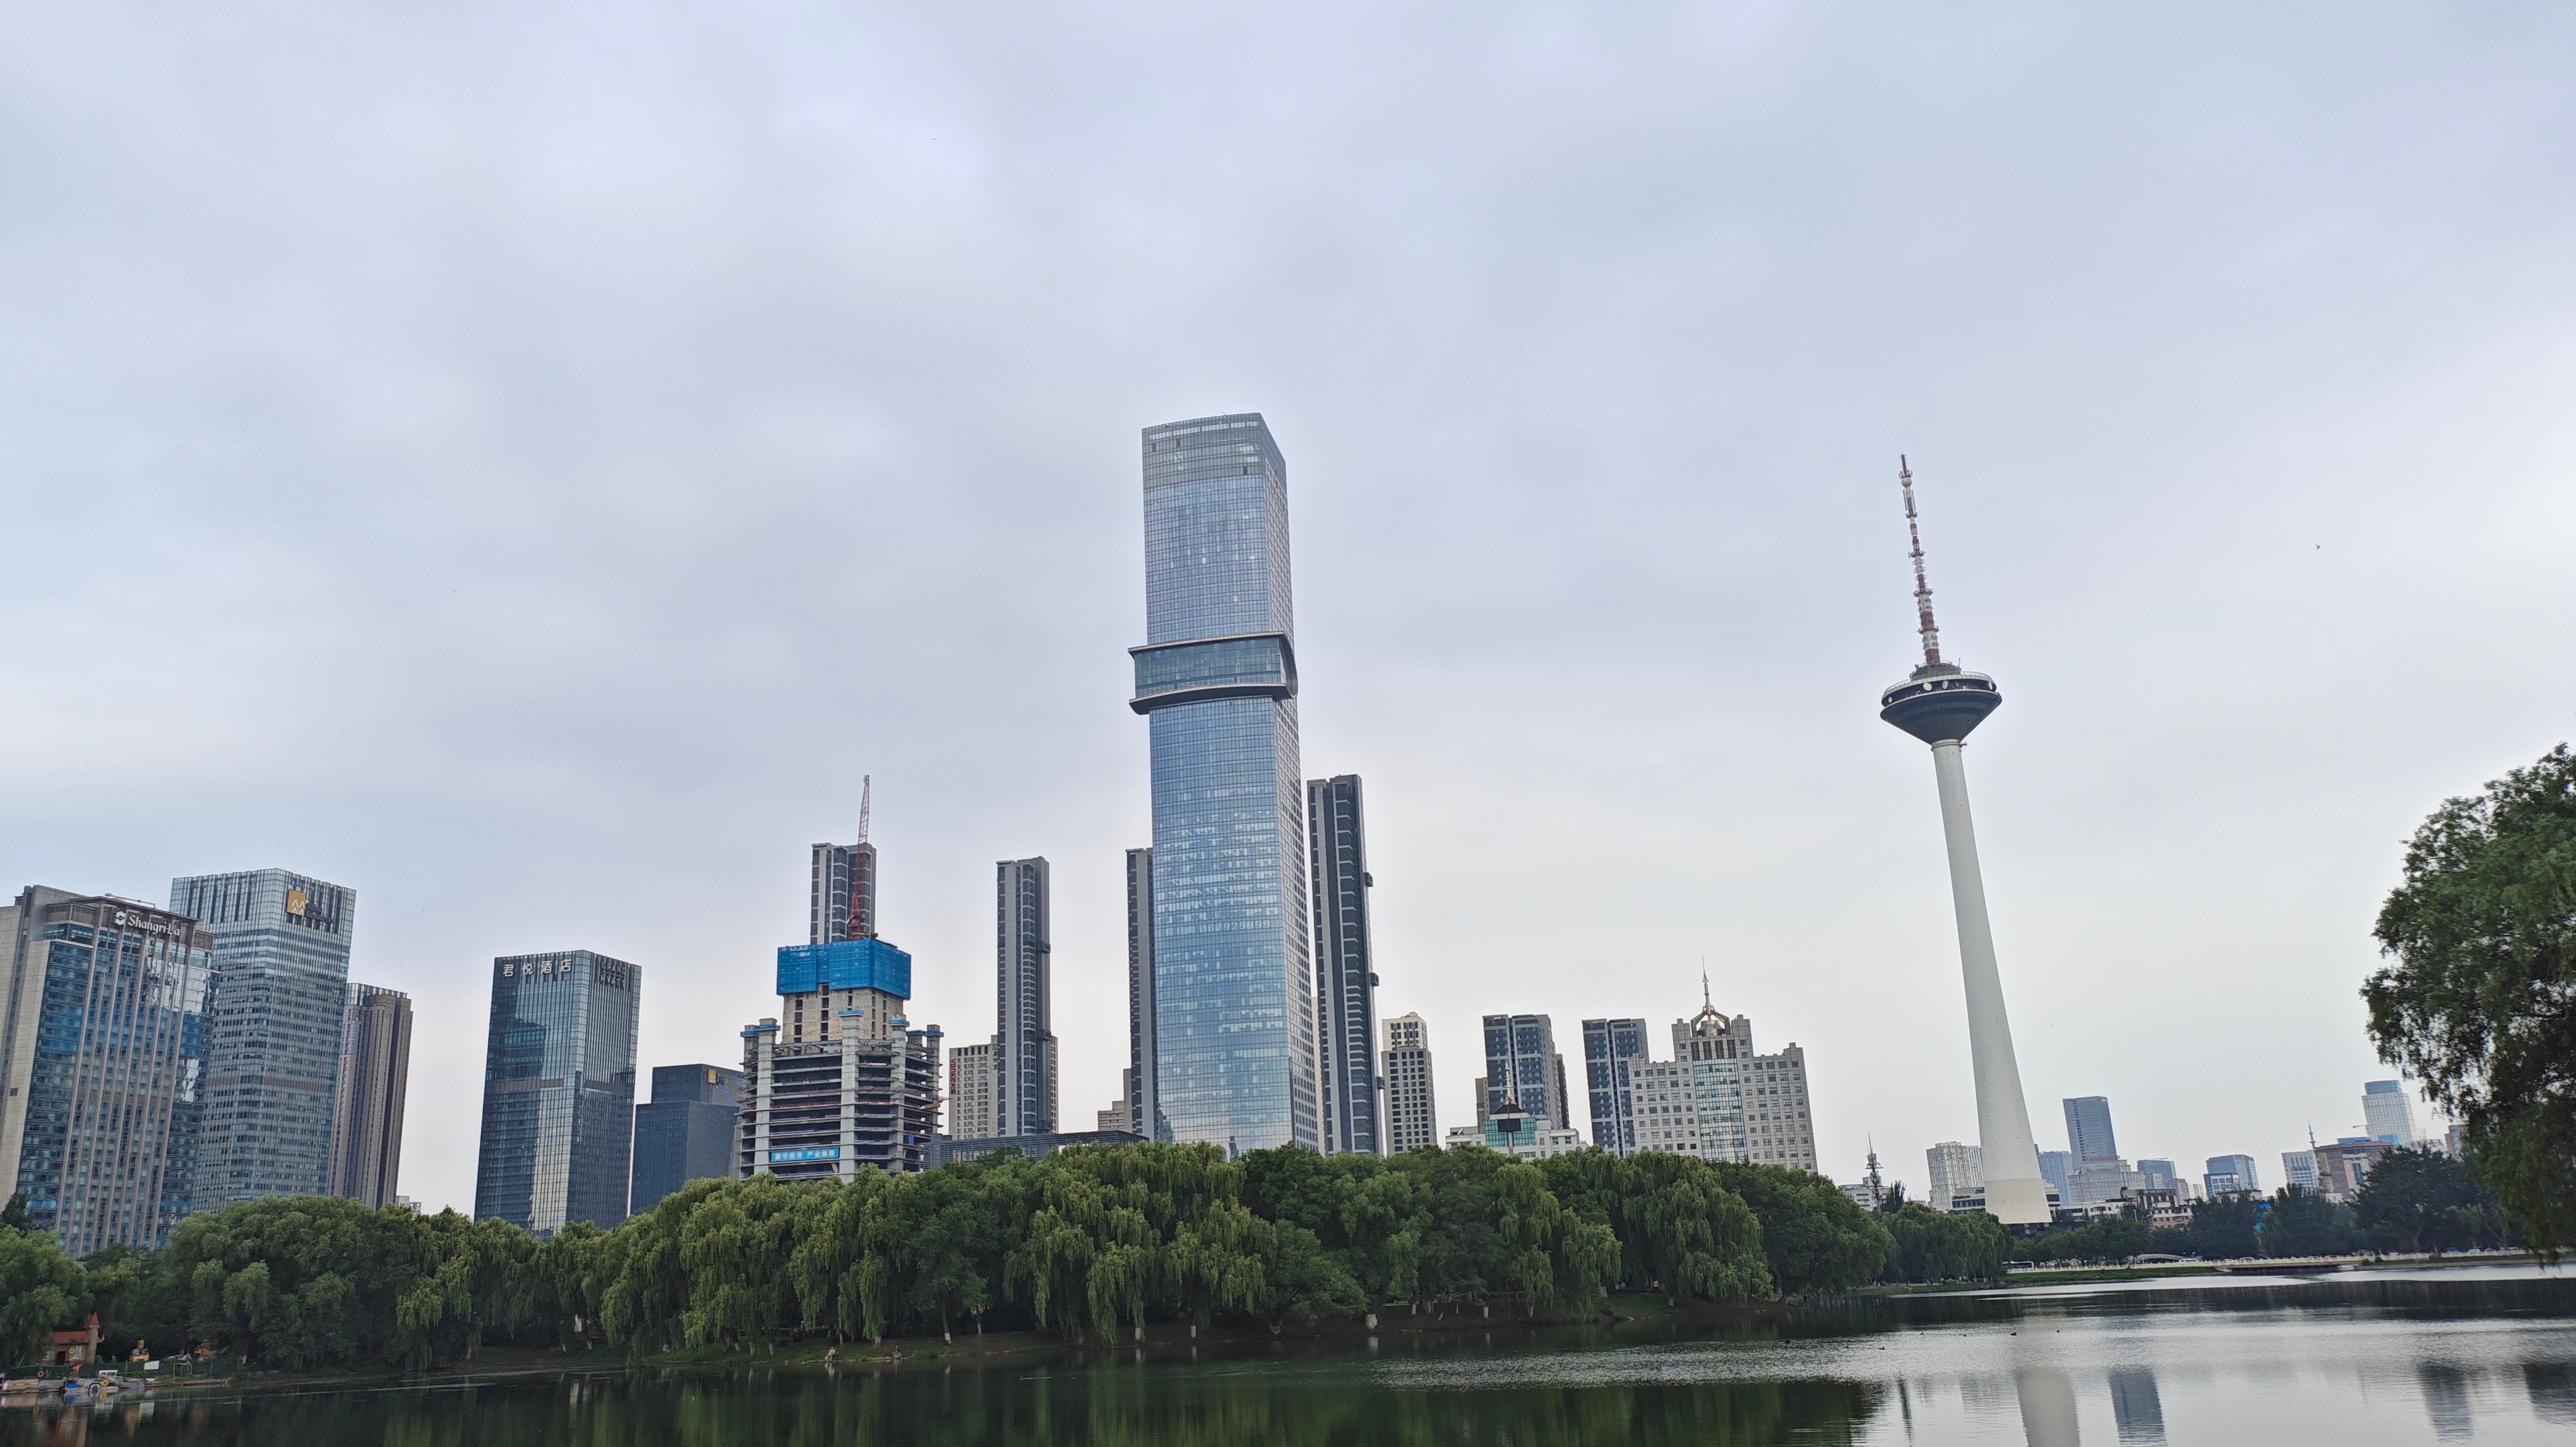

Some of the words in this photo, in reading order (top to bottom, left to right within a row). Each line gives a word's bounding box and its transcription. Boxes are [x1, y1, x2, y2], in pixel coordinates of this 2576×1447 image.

[128, 914, 181, 936] Shangri-La
[503, 959, 572, 977] 君悦酒店
[602, 962, 626, 975] GRAND
[600, 973, 626, 987] HYATT
